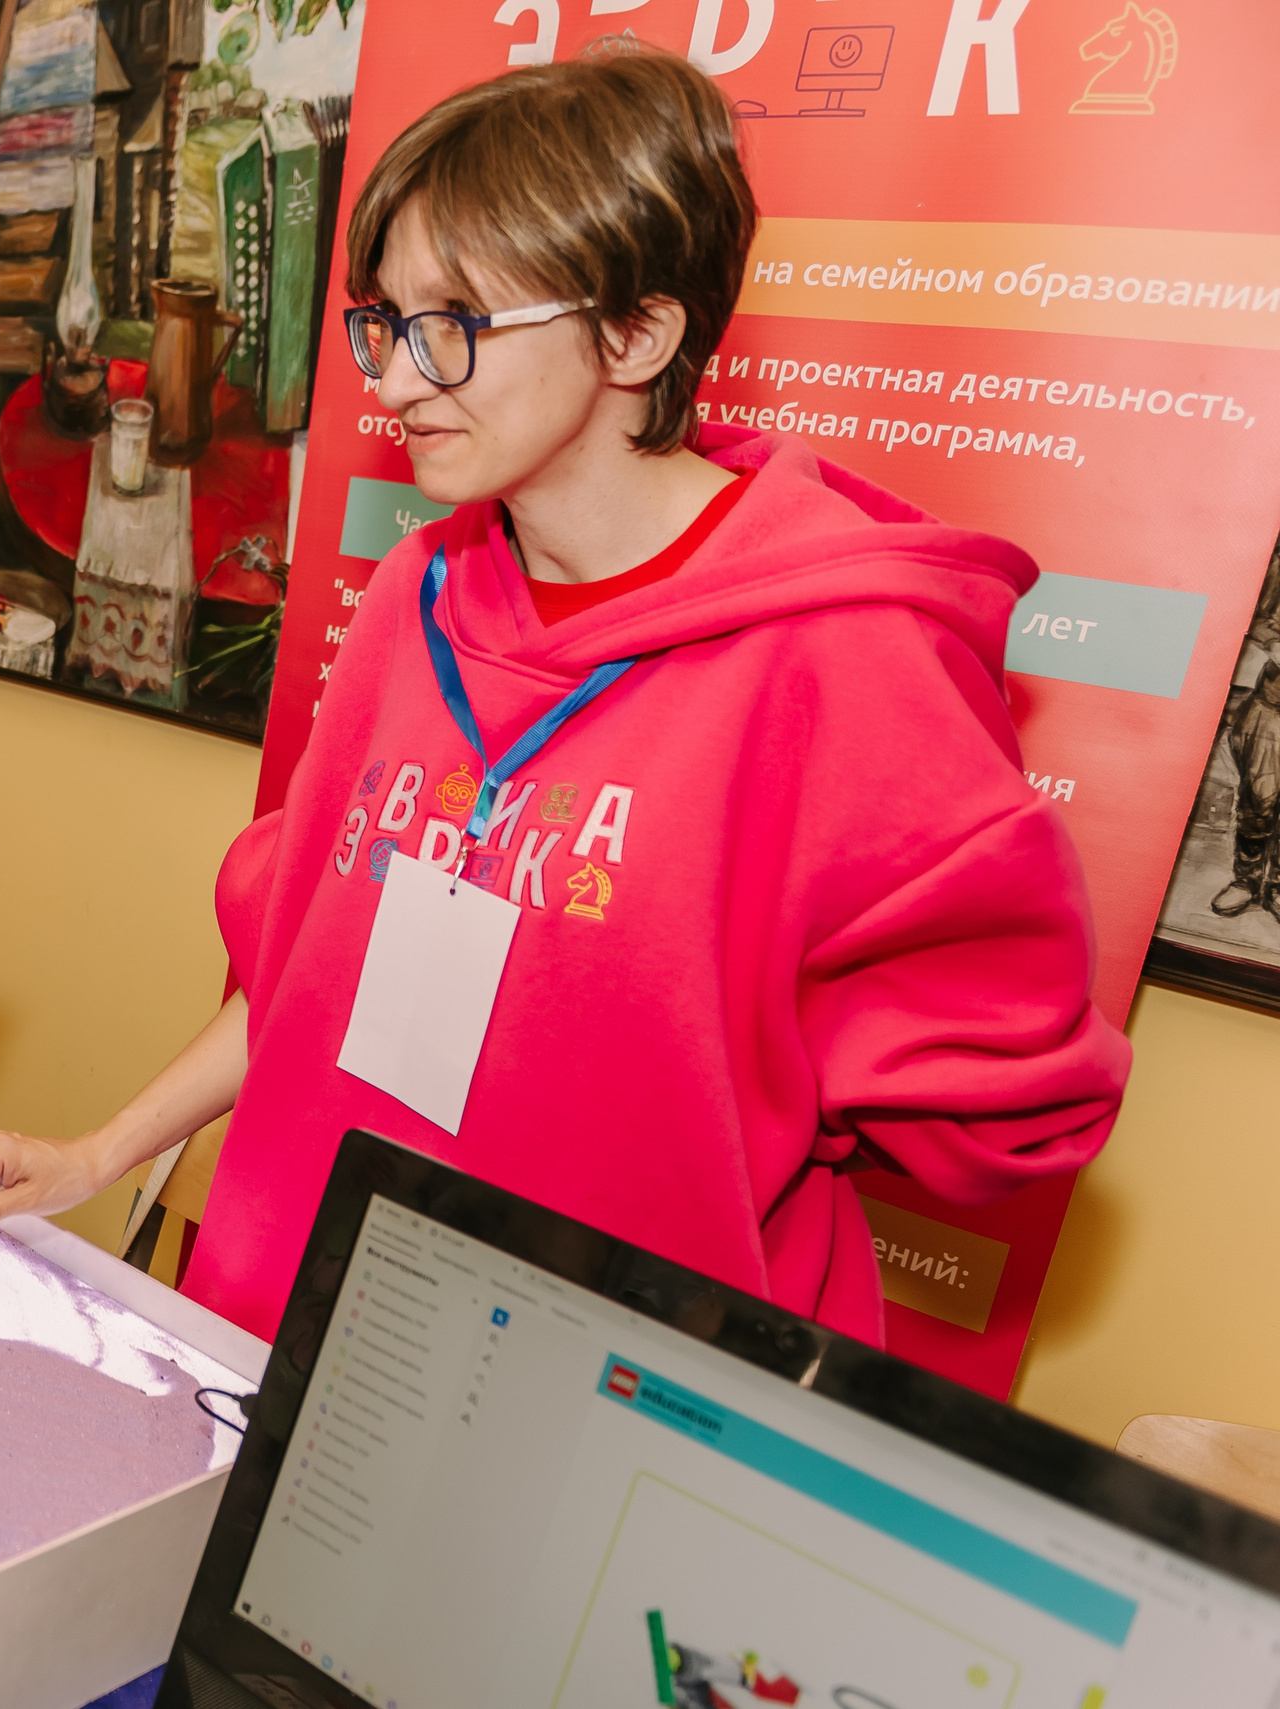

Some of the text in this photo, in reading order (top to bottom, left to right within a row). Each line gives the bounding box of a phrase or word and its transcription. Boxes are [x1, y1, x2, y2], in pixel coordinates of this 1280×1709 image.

[753, 257, 1280, 312] на семейном образовании
[728, 356, 750, 378] и
[757, 358, 945, 394] проектная
[949, 372, 1256, 430] деятельность,
[720, 402, 859, 440] учебная
[866, 418, 1086, 469] программа,
[1021, 613, 1098, 643] лет
